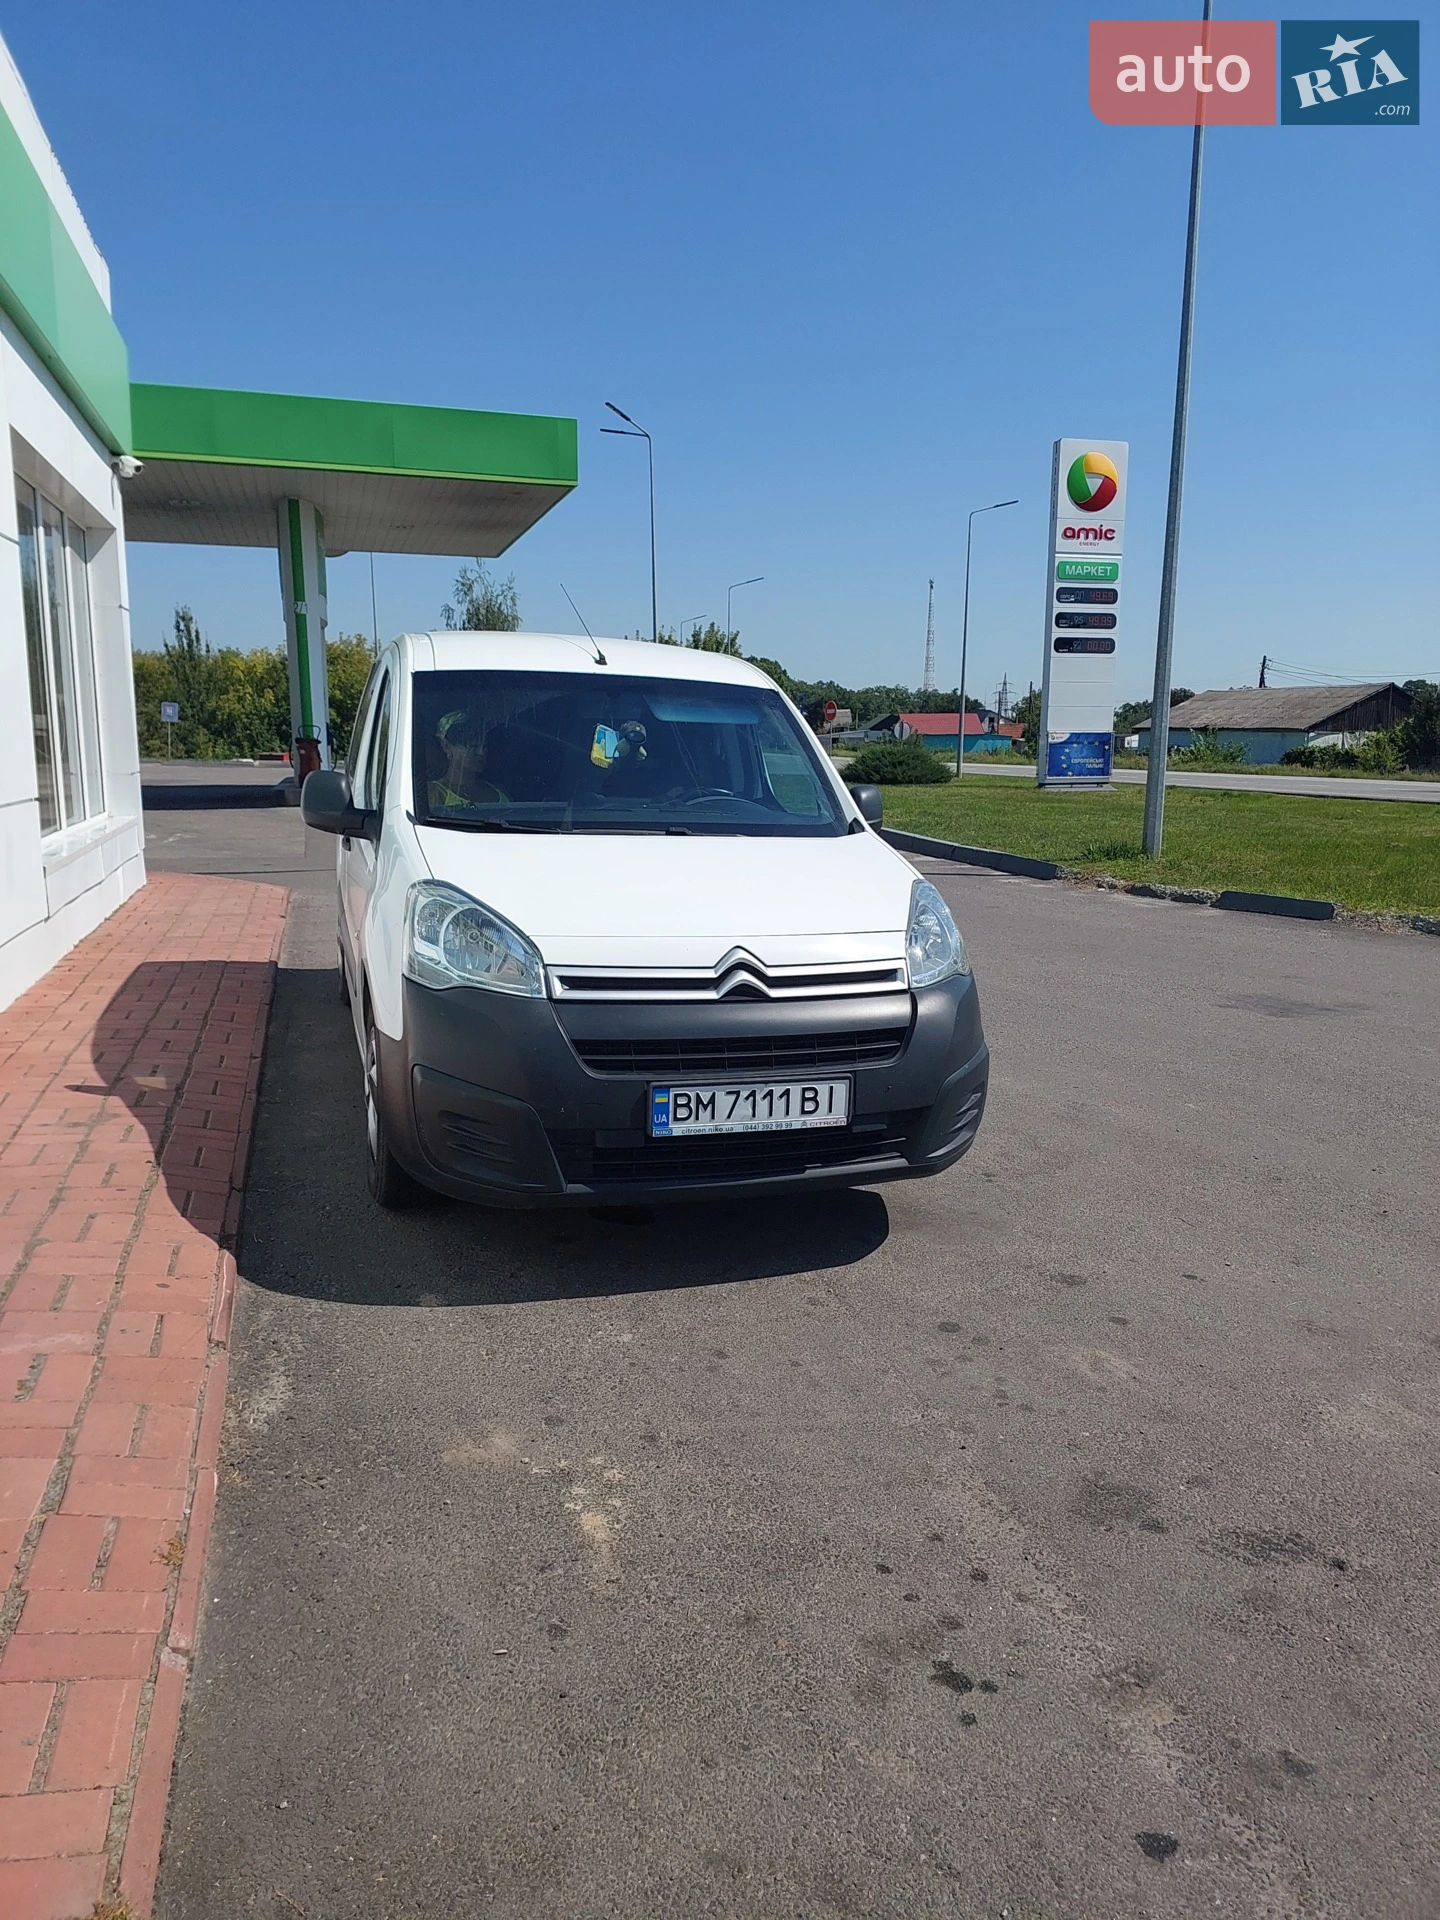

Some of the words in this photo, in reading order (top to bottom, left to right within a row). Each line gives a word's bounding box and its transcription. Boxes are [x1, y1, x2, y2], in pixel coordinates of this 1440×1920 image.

[1062, 524, 1116, 541] amic
[1065, 564, 1113, 577] МАРКЕТ
[673, 1091, 716, 1122] BM
[724, 1087, 792, 1119] 7111
[801, 1085, 834, 1115] BI
[654, 1114, 668, 1123] UA
[742, 1123, 759, 1131] (044)
[775, 1122, 783, 1130] 99
